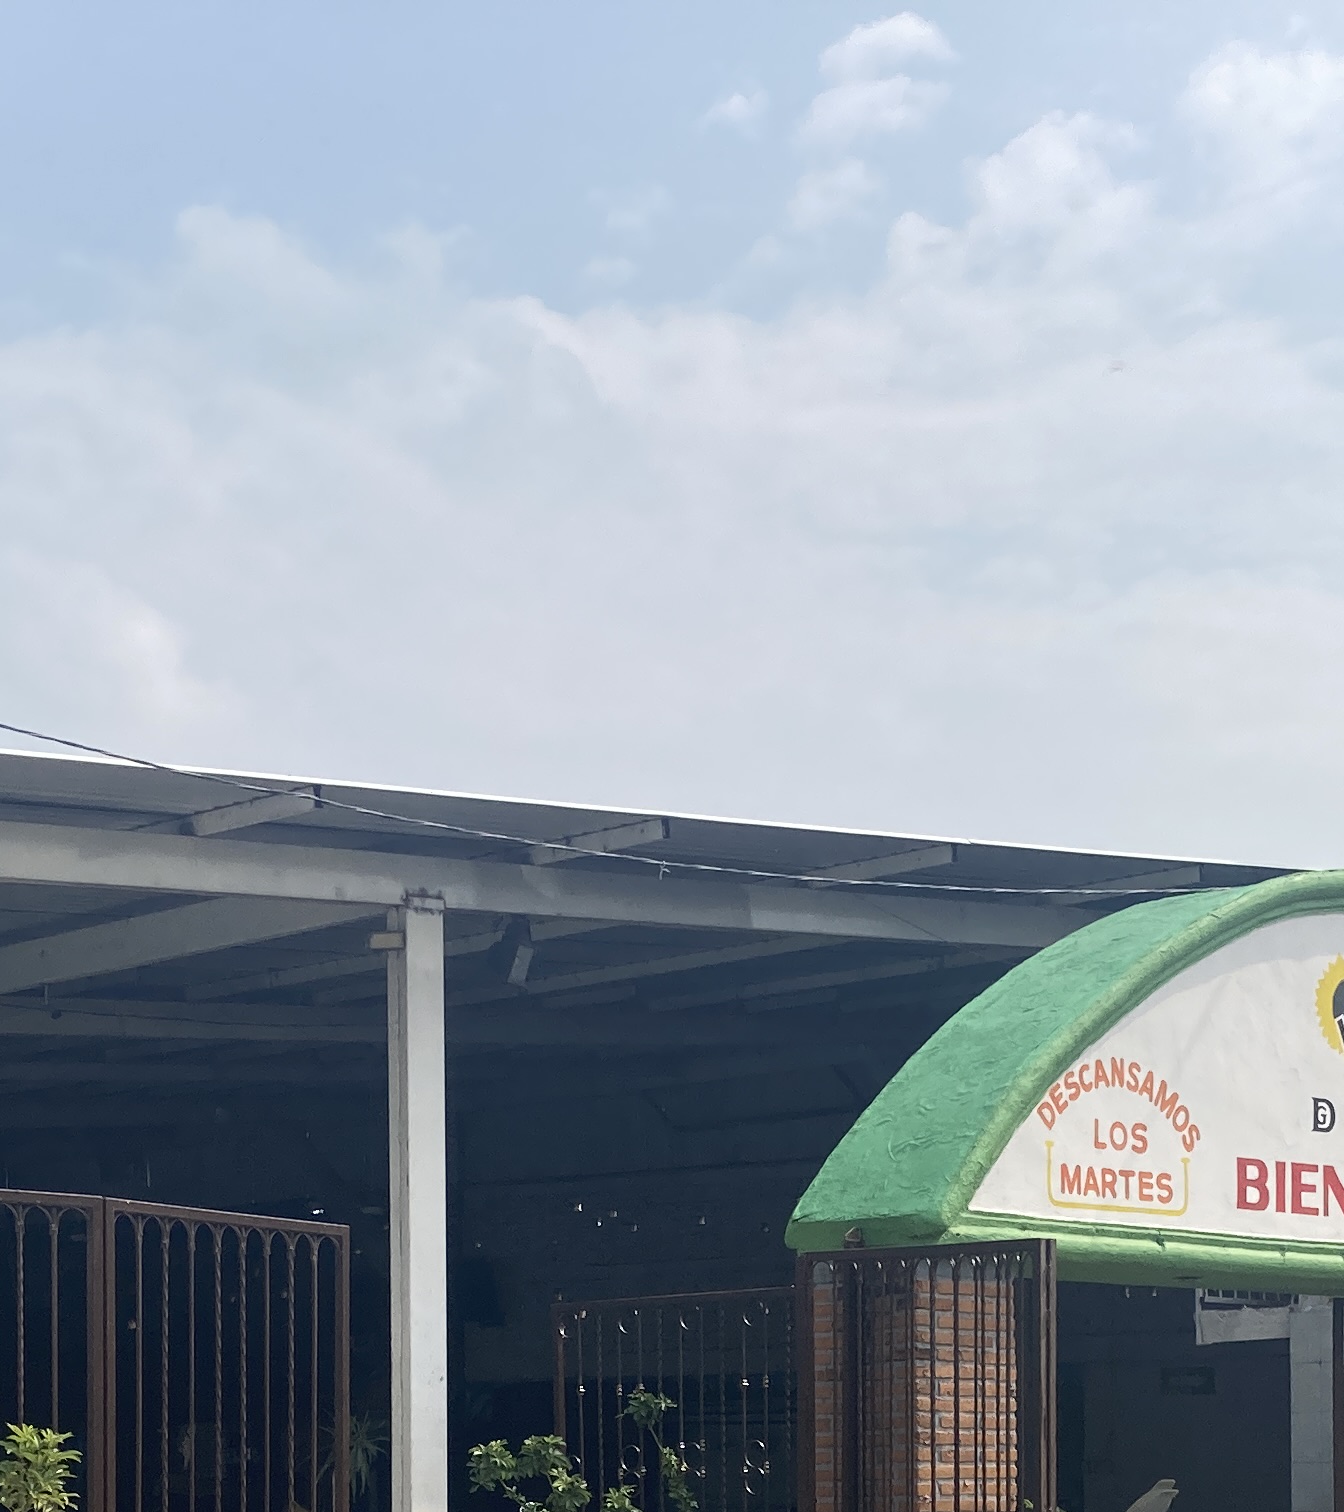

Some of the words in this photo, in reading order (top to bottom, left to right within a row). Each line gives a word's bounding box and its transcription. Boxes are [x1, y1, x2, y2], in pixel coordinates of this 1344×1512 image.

[1037, 1056, 1201, 1153] DESCANSAMOS
[1094, 1118, 1148, 1154] LOS
[1060, 1163, 1174, 1204] MARTES
